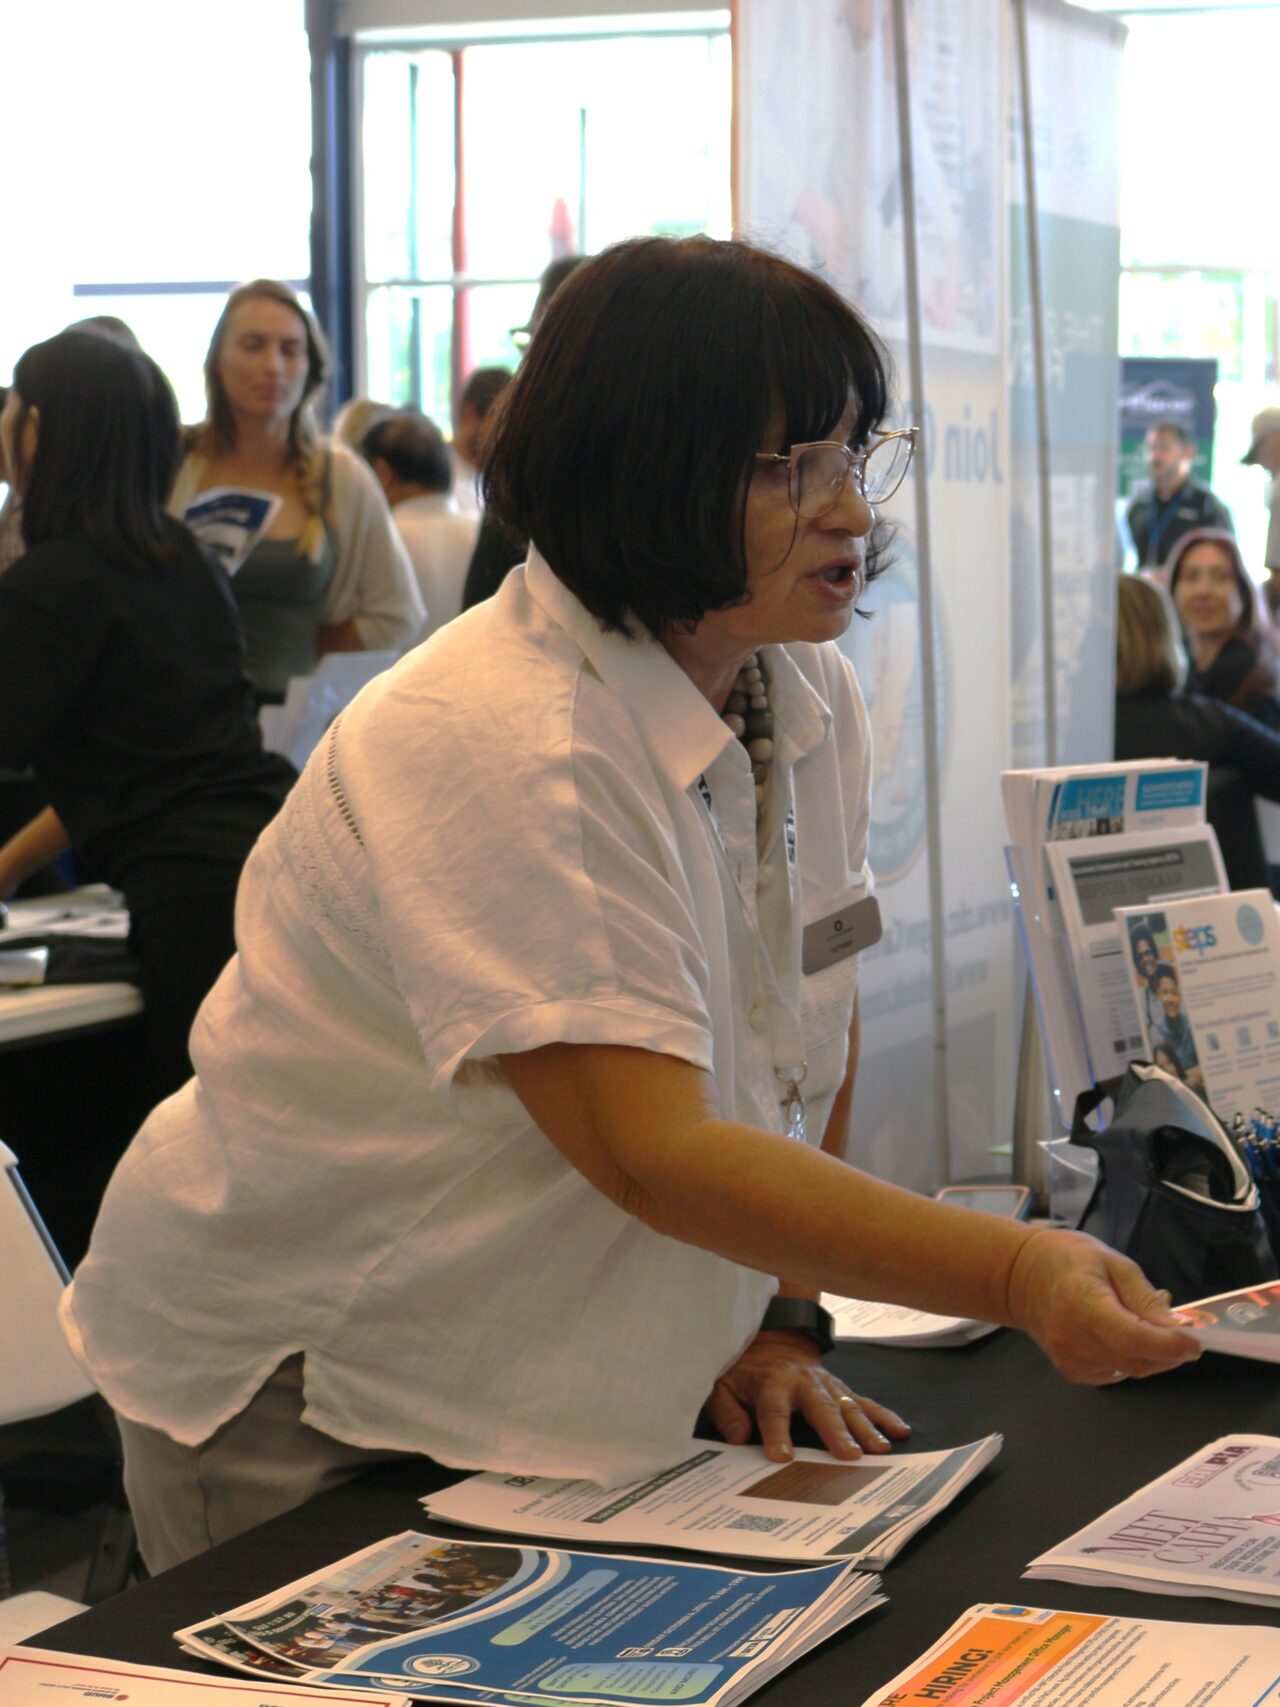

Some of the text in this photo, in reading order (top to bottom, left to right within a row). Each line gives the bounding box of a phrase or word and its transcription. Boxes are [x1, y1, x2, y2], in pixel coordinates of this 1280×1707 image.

[1173, 925, 1217, 957] steps
[1092, 1509, 1202, 1558] MEET
[1153, 1516, 1254, 1564] CALPIA
[913, 1648, 995, 1699] HIRING!
[973, 1688, 1000, 1705] Project
[992, 1656, 1036, 1689] Management
